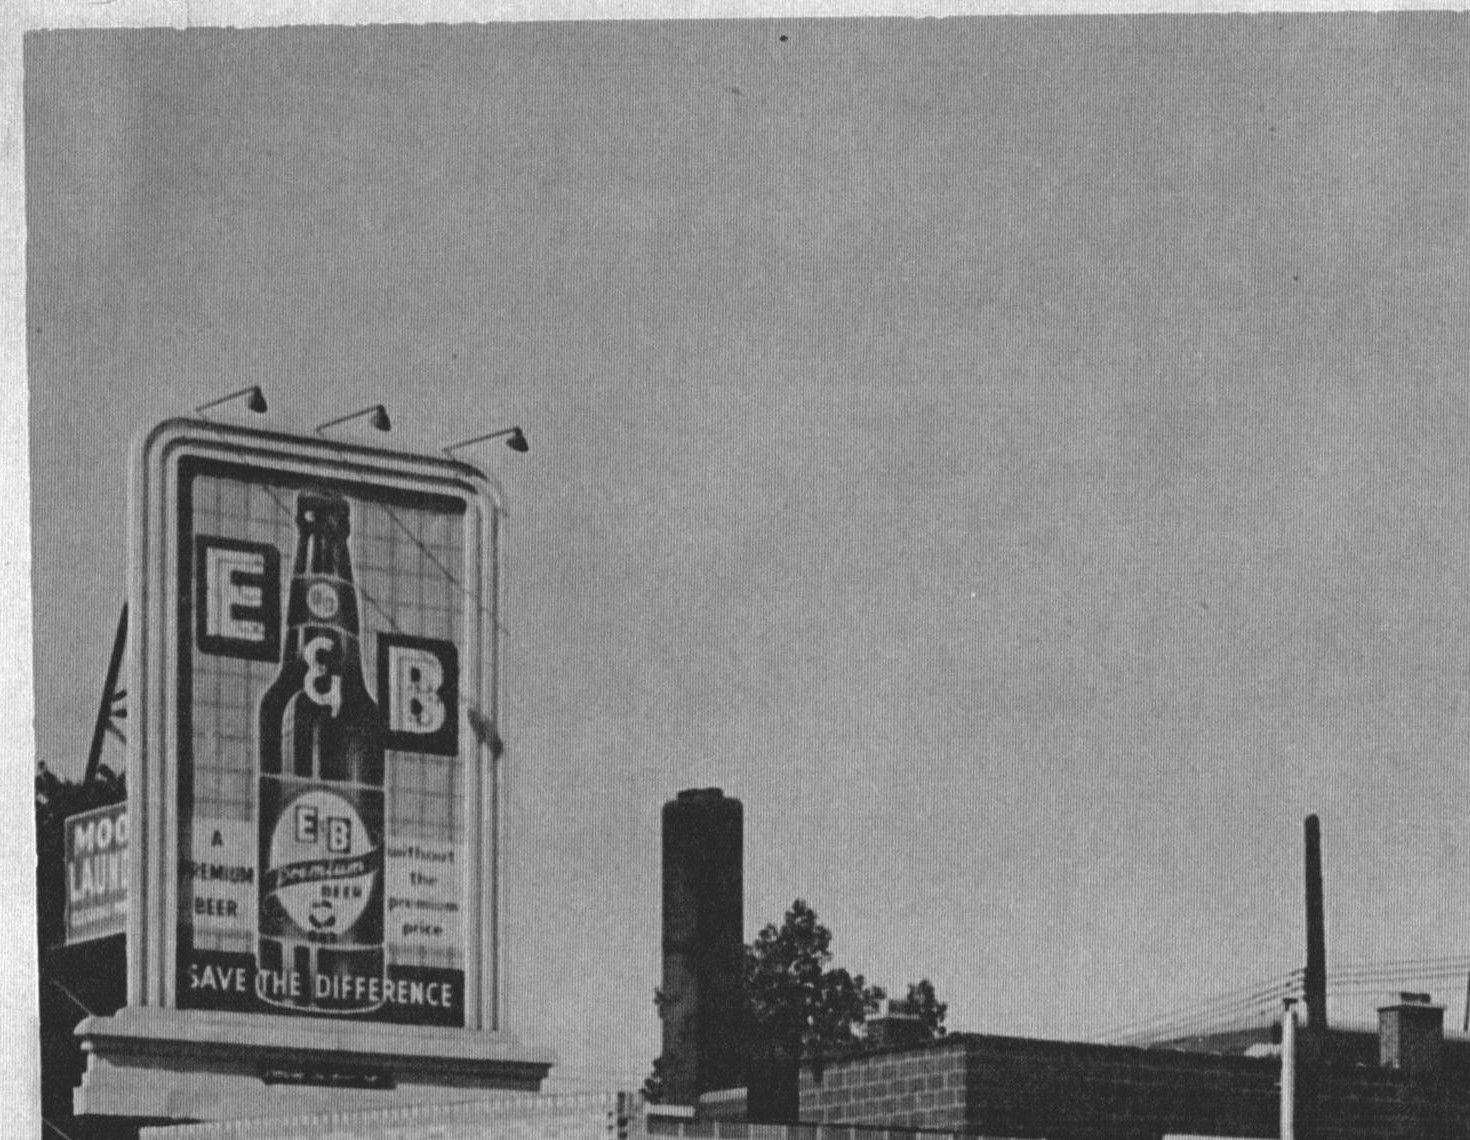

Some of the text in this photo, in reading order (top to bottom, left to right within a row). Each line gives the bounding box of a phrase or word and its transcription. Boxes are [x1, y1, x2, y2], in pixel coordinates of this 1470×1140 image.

[206, 547, 447, 734] E & B
[211, 829, 224, 847] A
[298, 808, 349, 852] E B
[184, 861, 254, 883] REMIUM
[195, 897, 237, 917] BEER
[402, 922, 442, 936] price
[191, 964, 452, 1008] SAVE THE DIFFERENCE
